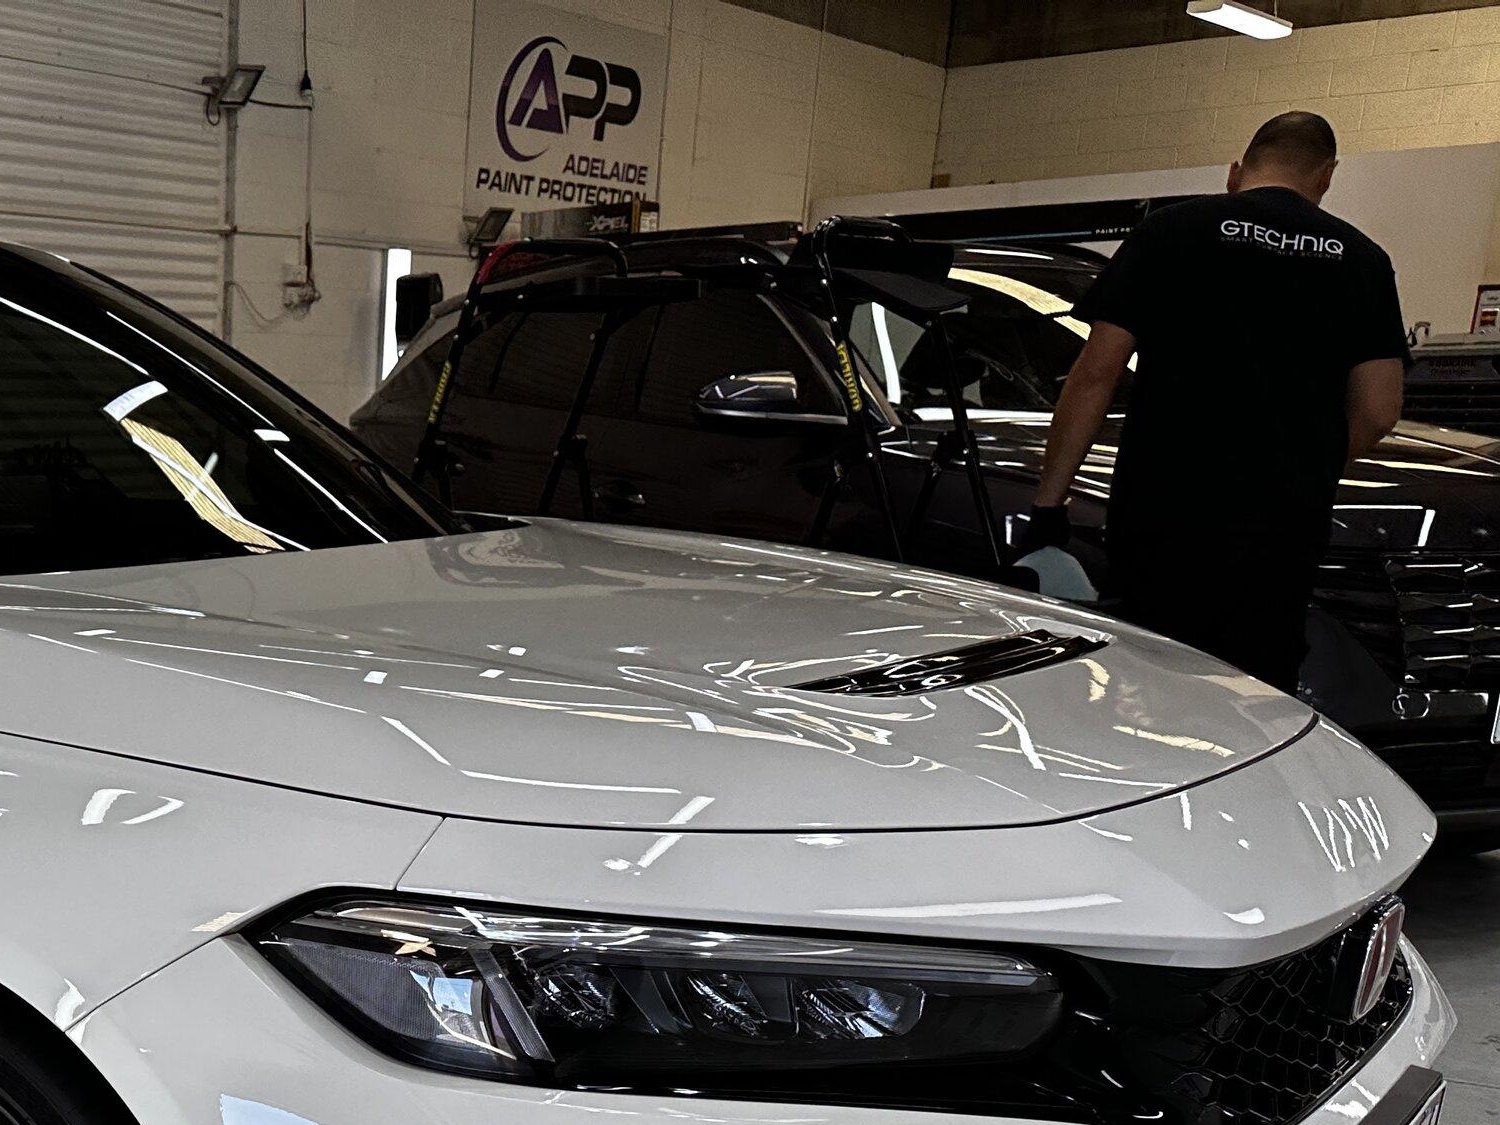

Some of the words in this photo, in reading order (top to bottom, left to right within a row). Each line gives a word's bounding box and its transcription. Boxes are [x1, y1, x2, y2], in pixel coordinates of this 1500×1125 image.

[508, 48, 642, 142] APP
[476, 167, 535, 196] PAINT
[562, 154, 649, 186] ADELAIDE
[1220, 219, 1344, 255] GTECHNIQ
